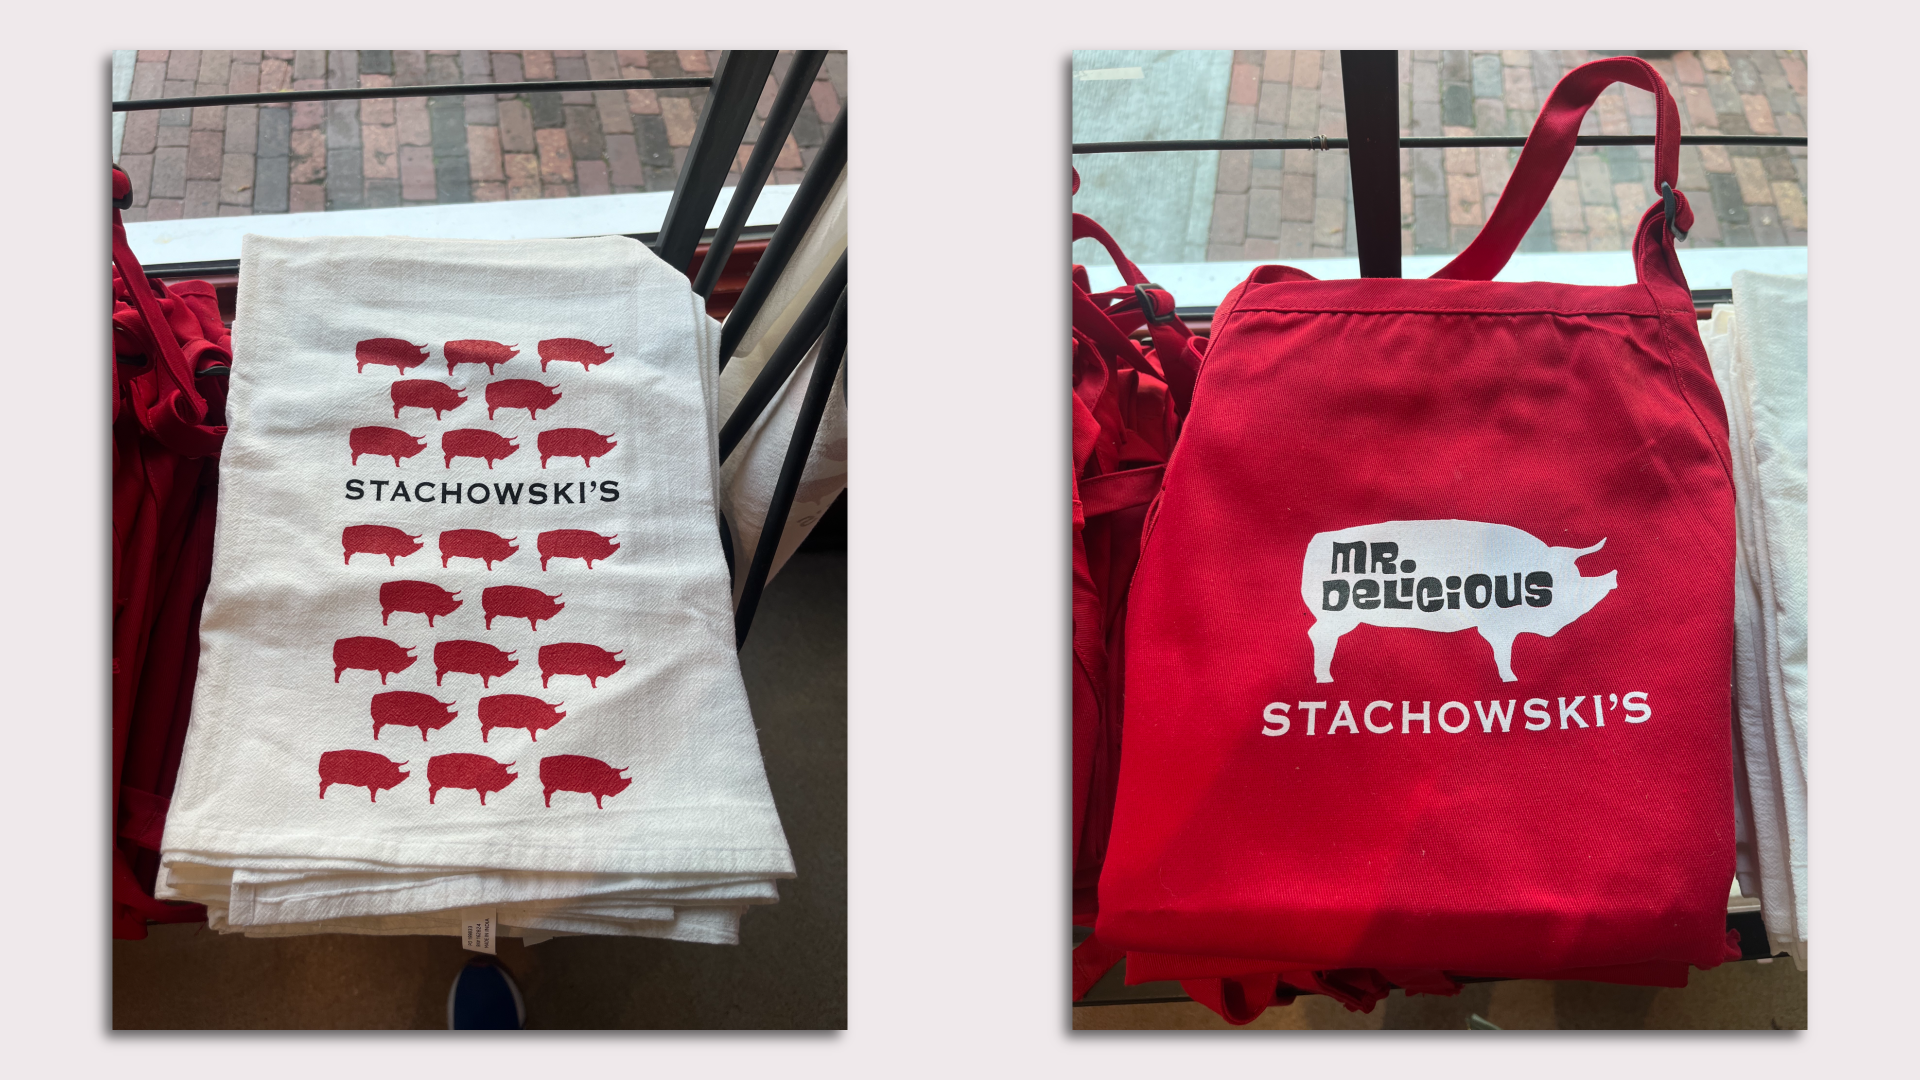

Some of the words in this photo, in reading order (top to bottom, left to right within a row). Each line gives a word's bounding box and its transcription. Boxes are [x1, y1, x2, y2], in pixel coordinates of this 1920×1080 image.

[345, 478, 620, 505] STACHOWSKI'S
[1331, 541, 1417, 575] MR.
[1261, 691, 1652, 737] STACHOWSKI'S
